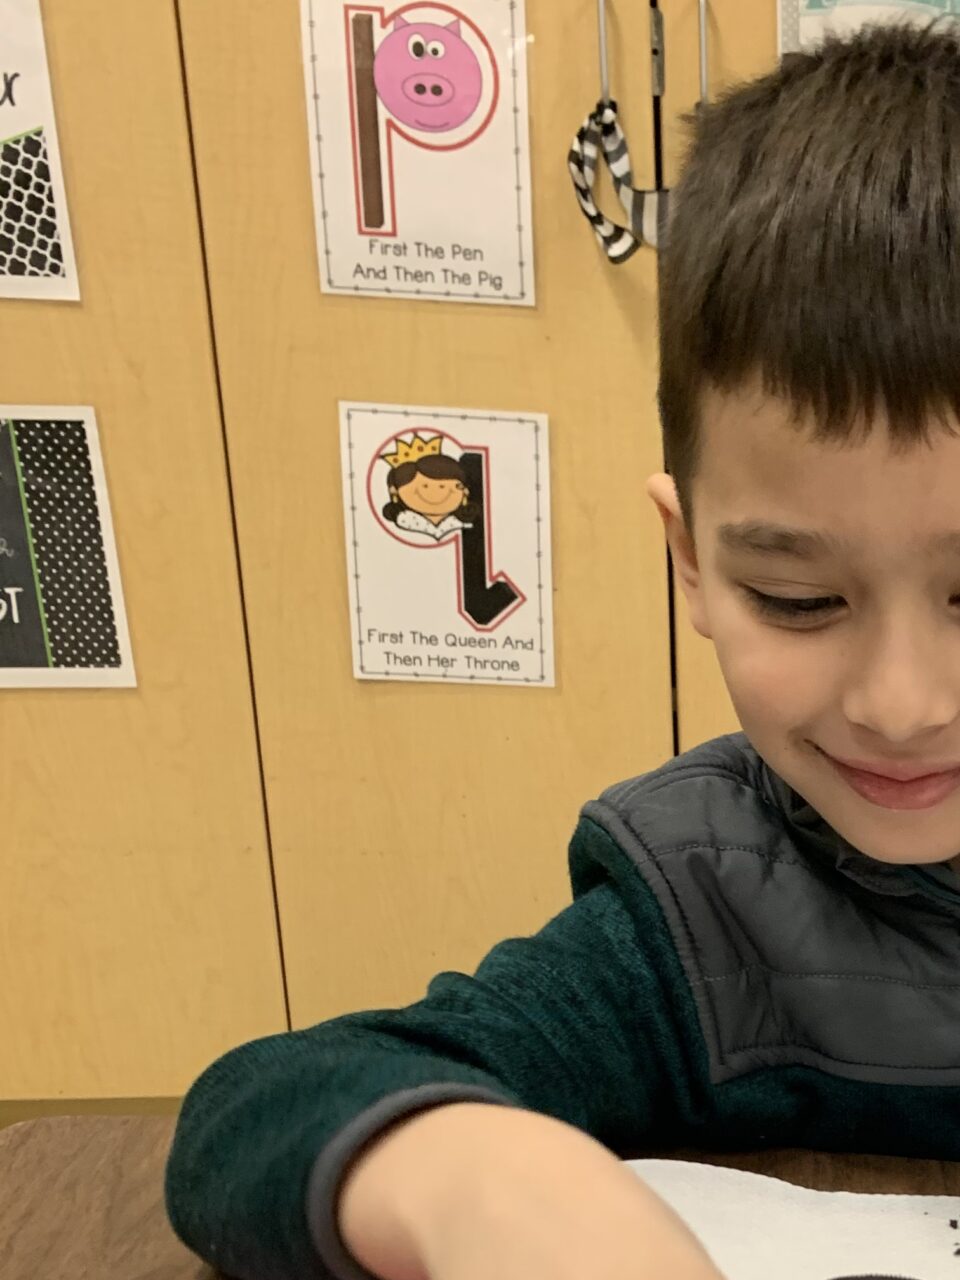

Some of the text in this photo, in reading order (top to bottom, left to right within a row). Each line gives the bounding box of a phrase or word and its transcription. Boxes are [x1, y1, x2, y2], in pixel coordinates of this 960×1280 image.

[369, 239, 484, 261] First The Pen
[352, 263, 504, 291] And Then The Pig
[367, 628, 535, 651] First The Queen And
[384, 651, 521, 672] Then Her Throne
